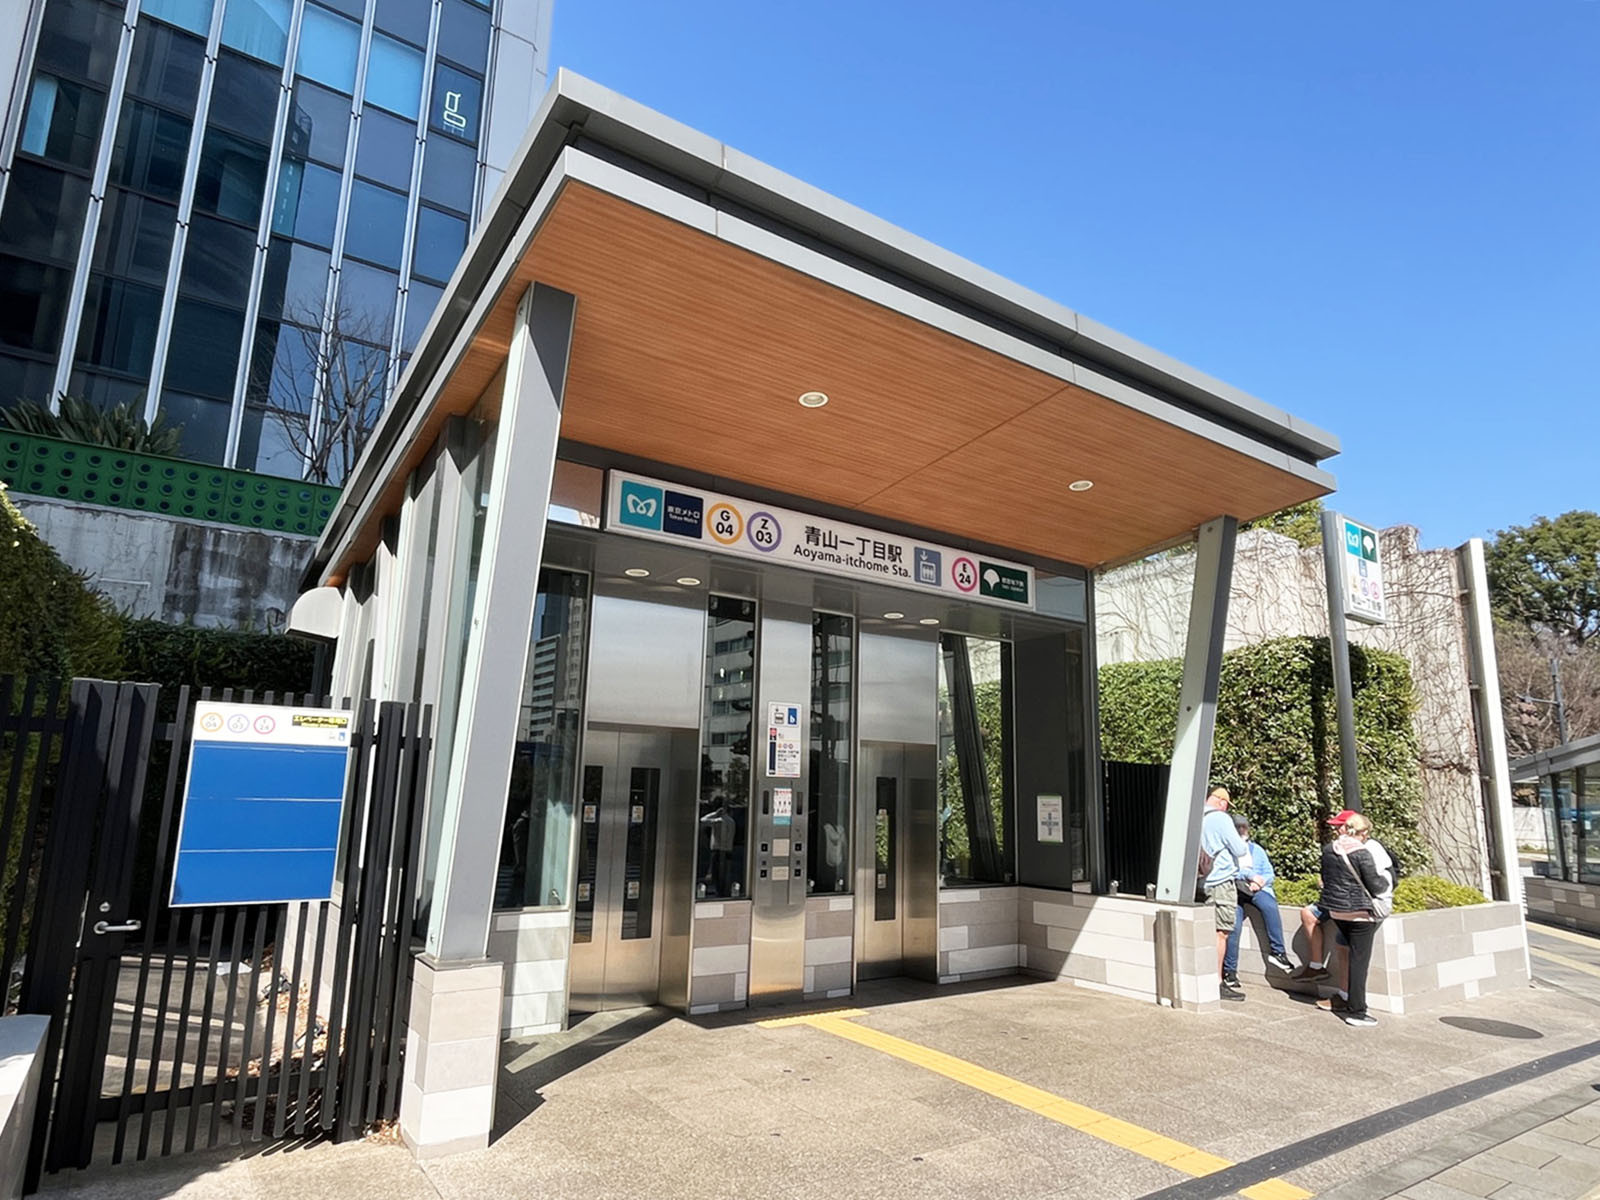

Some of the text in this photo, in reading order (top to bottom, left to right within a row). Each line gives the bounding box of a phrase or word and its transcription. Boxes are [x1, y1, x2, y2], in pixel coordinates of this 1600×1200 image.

[720, 510, 731, 522] G
[715, 521, 734, 536] 04
[760, 518, 769, 530] Z
[755, 530, 773, 544] 03
[804, 525, 903, 564] 青山一丁目駅
[793, 544, 912, 579] Aoyama-itchome Sta.
[962, 564, 967, 573] E
[958, 573, 971, 585] 24
